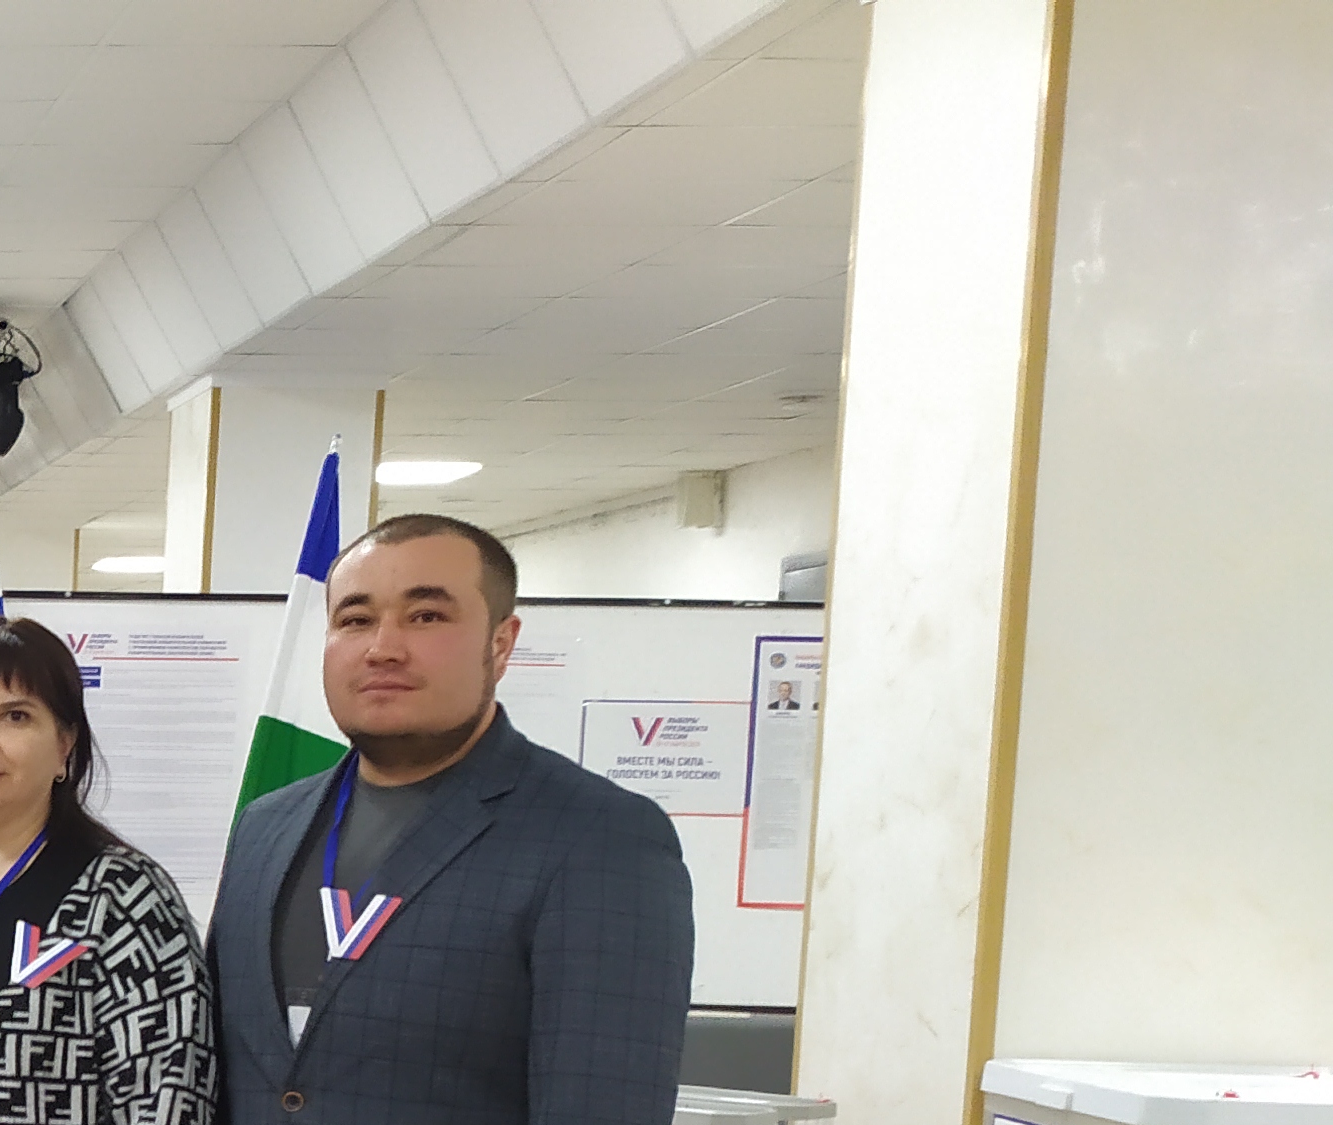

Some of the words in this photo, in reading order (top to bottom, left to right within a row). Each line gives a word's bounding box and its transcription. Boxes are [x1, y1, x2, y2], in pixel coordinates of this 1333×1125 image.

[616, 756, 655, 766] ВМЕСТЕ
[657, 756, 676, 766] МЫ
[677, 757, 704, 767] СИЛА
[606, 768, 660, 779] ГОЛОСУЕМ
[661, 770, 673, 780] ЗА
[675, 770, 721, 780] РОССИЮ!
